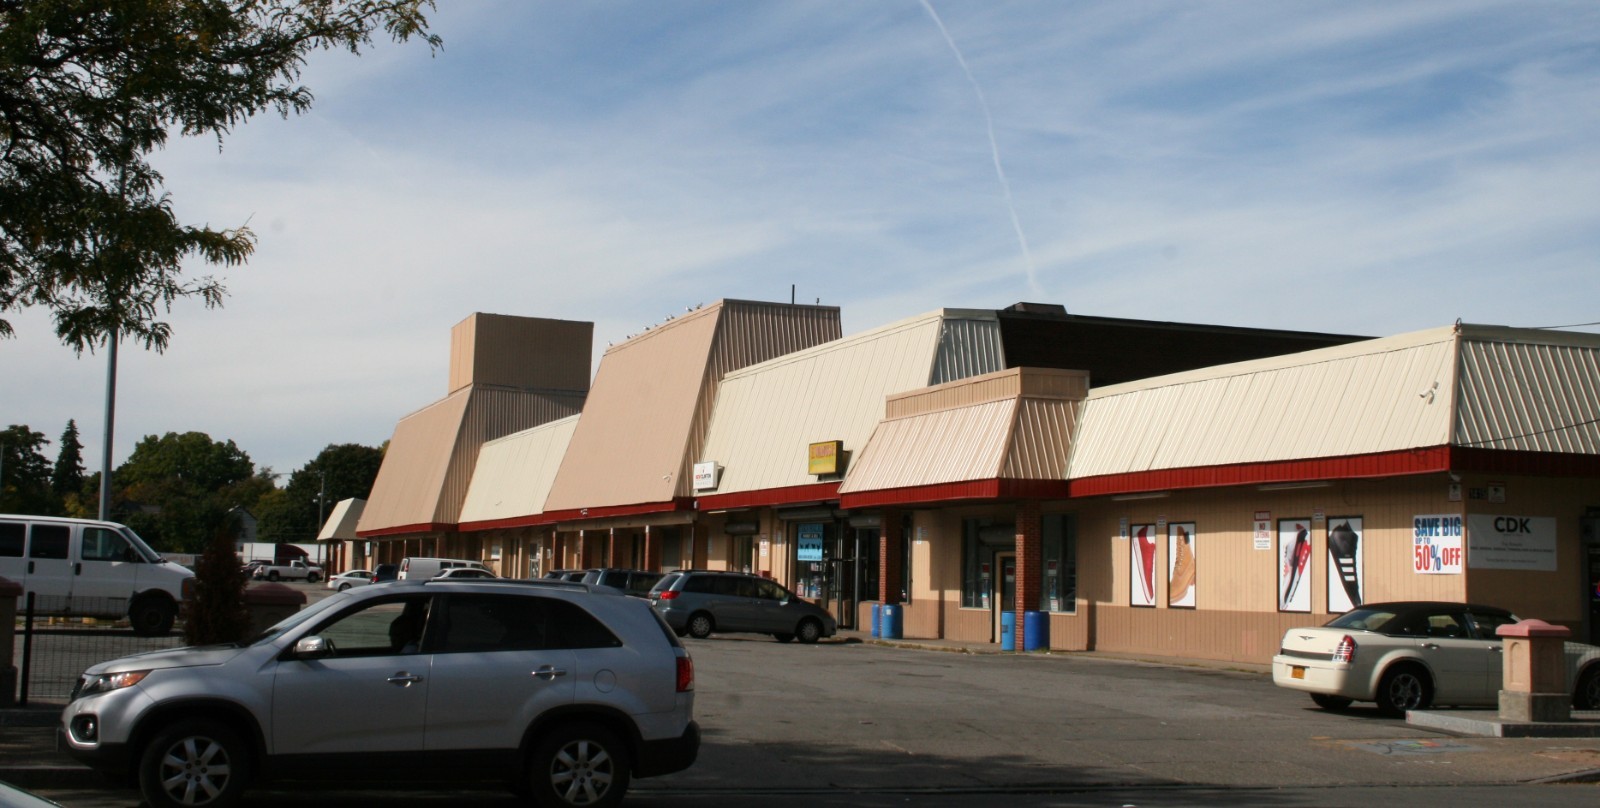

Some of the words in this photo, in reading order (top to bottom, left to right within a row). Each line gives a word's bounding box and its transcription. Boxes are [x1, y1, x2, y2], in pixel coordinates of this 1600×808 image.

[1415, 518, 1440, 537] SAVE
[1442, 517, 1461, 536] BIG
[1495, 517, 1531, 533] CDK
[1415, 545, 1441, 571] 50%
[1442, 548, 1460, 565] OFF
